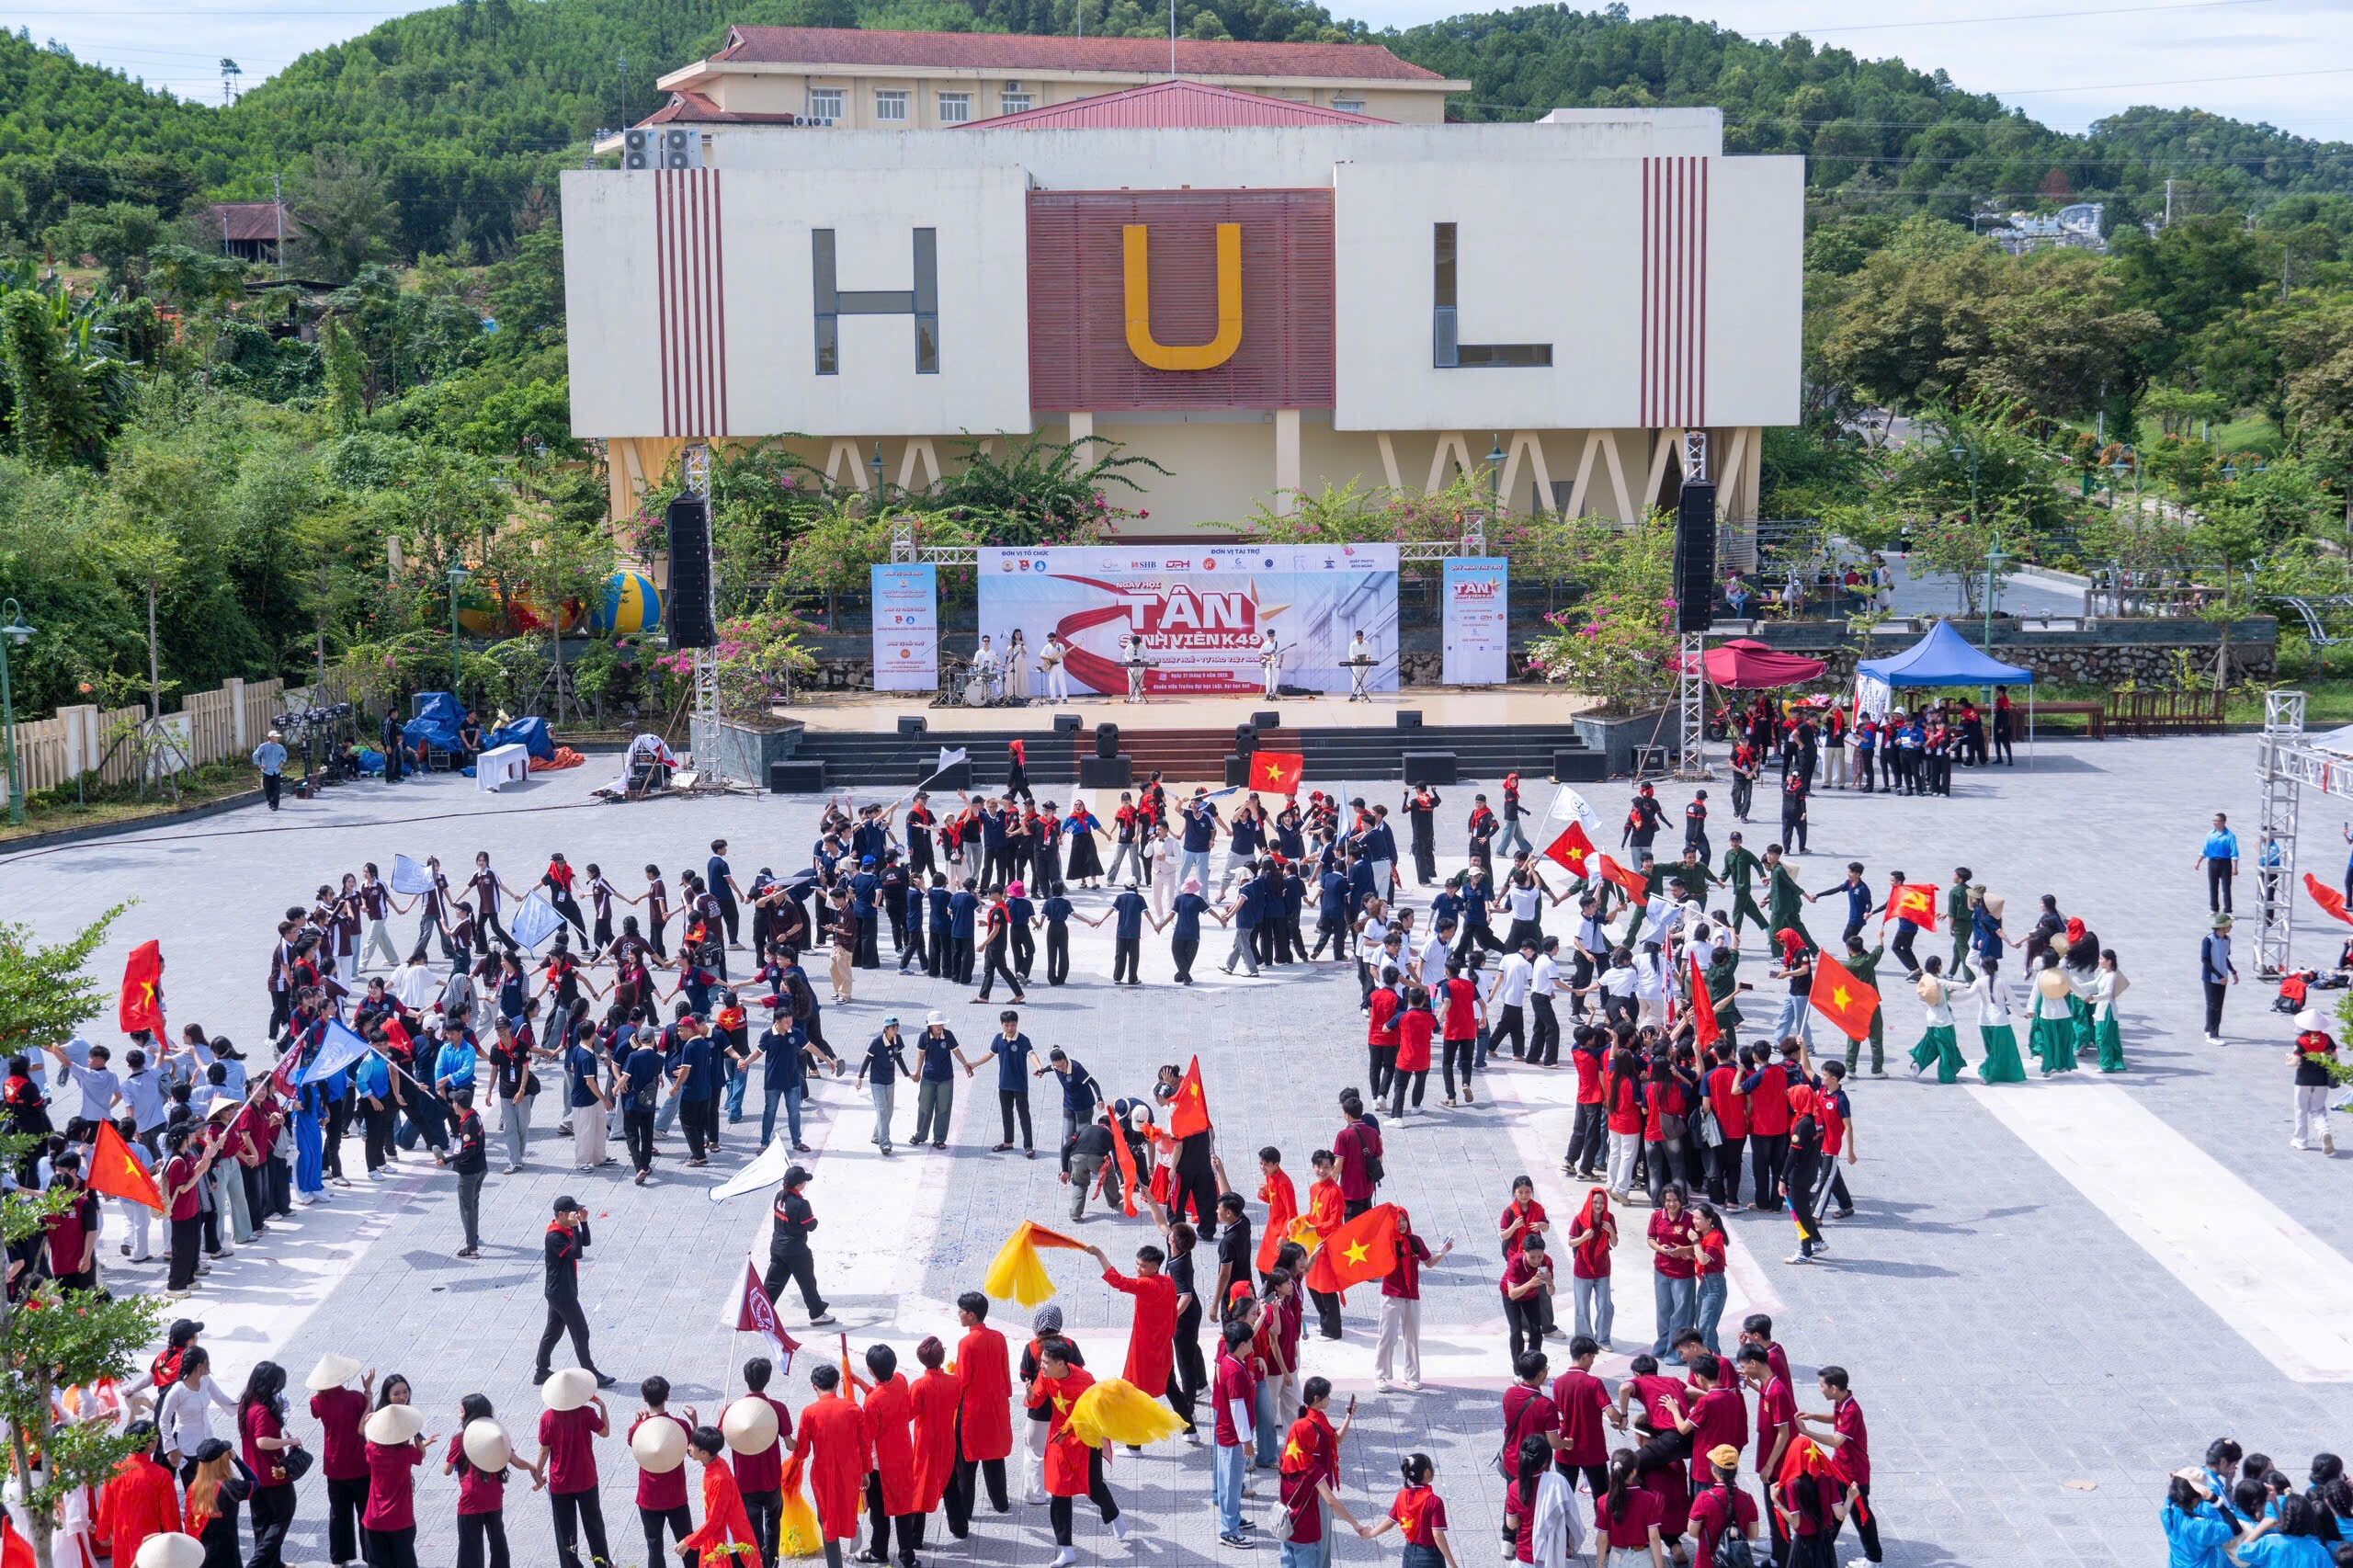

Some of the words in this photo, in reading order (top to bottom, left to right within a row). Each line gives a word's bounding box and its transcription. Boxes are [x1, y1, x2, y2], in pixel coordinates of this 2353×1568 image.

[1453, 580, 1491, 595] TÂN
[1117, 585, 1245, 631] TÂN
[1119, 633, 1169, 647] SNH
[1170, 631, 1220, 646] VIÊN
[1222, 633, 1262, 647] K49
